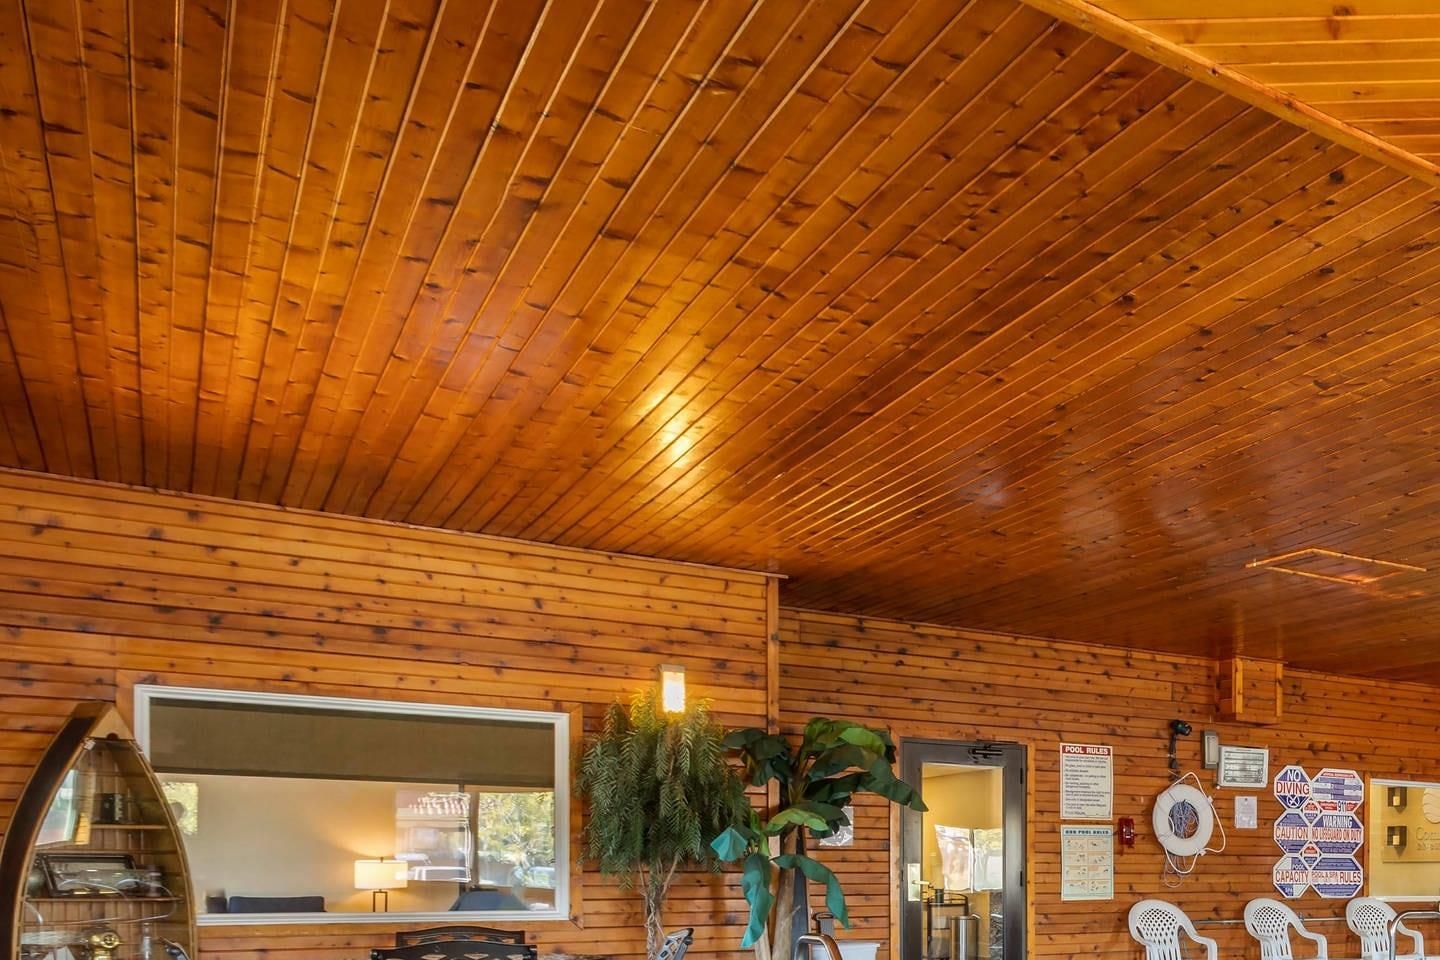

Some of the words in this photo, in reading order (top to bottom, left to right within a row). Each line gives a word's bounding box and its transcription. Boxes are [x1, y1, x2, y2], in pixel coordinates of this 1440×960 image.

[1086, 747, 1108, 755] RULES
[1287, 769, 1301, 782] NO
[1276, 782, 1310, 795] DIVING
[1322, 815, 1352, 828] WARNING
[1275, 826, 1309, 840] CAUTION
[1275, 871, 1309, 883] CAPACITY
[1339, 872, 1361, 883] RULES
